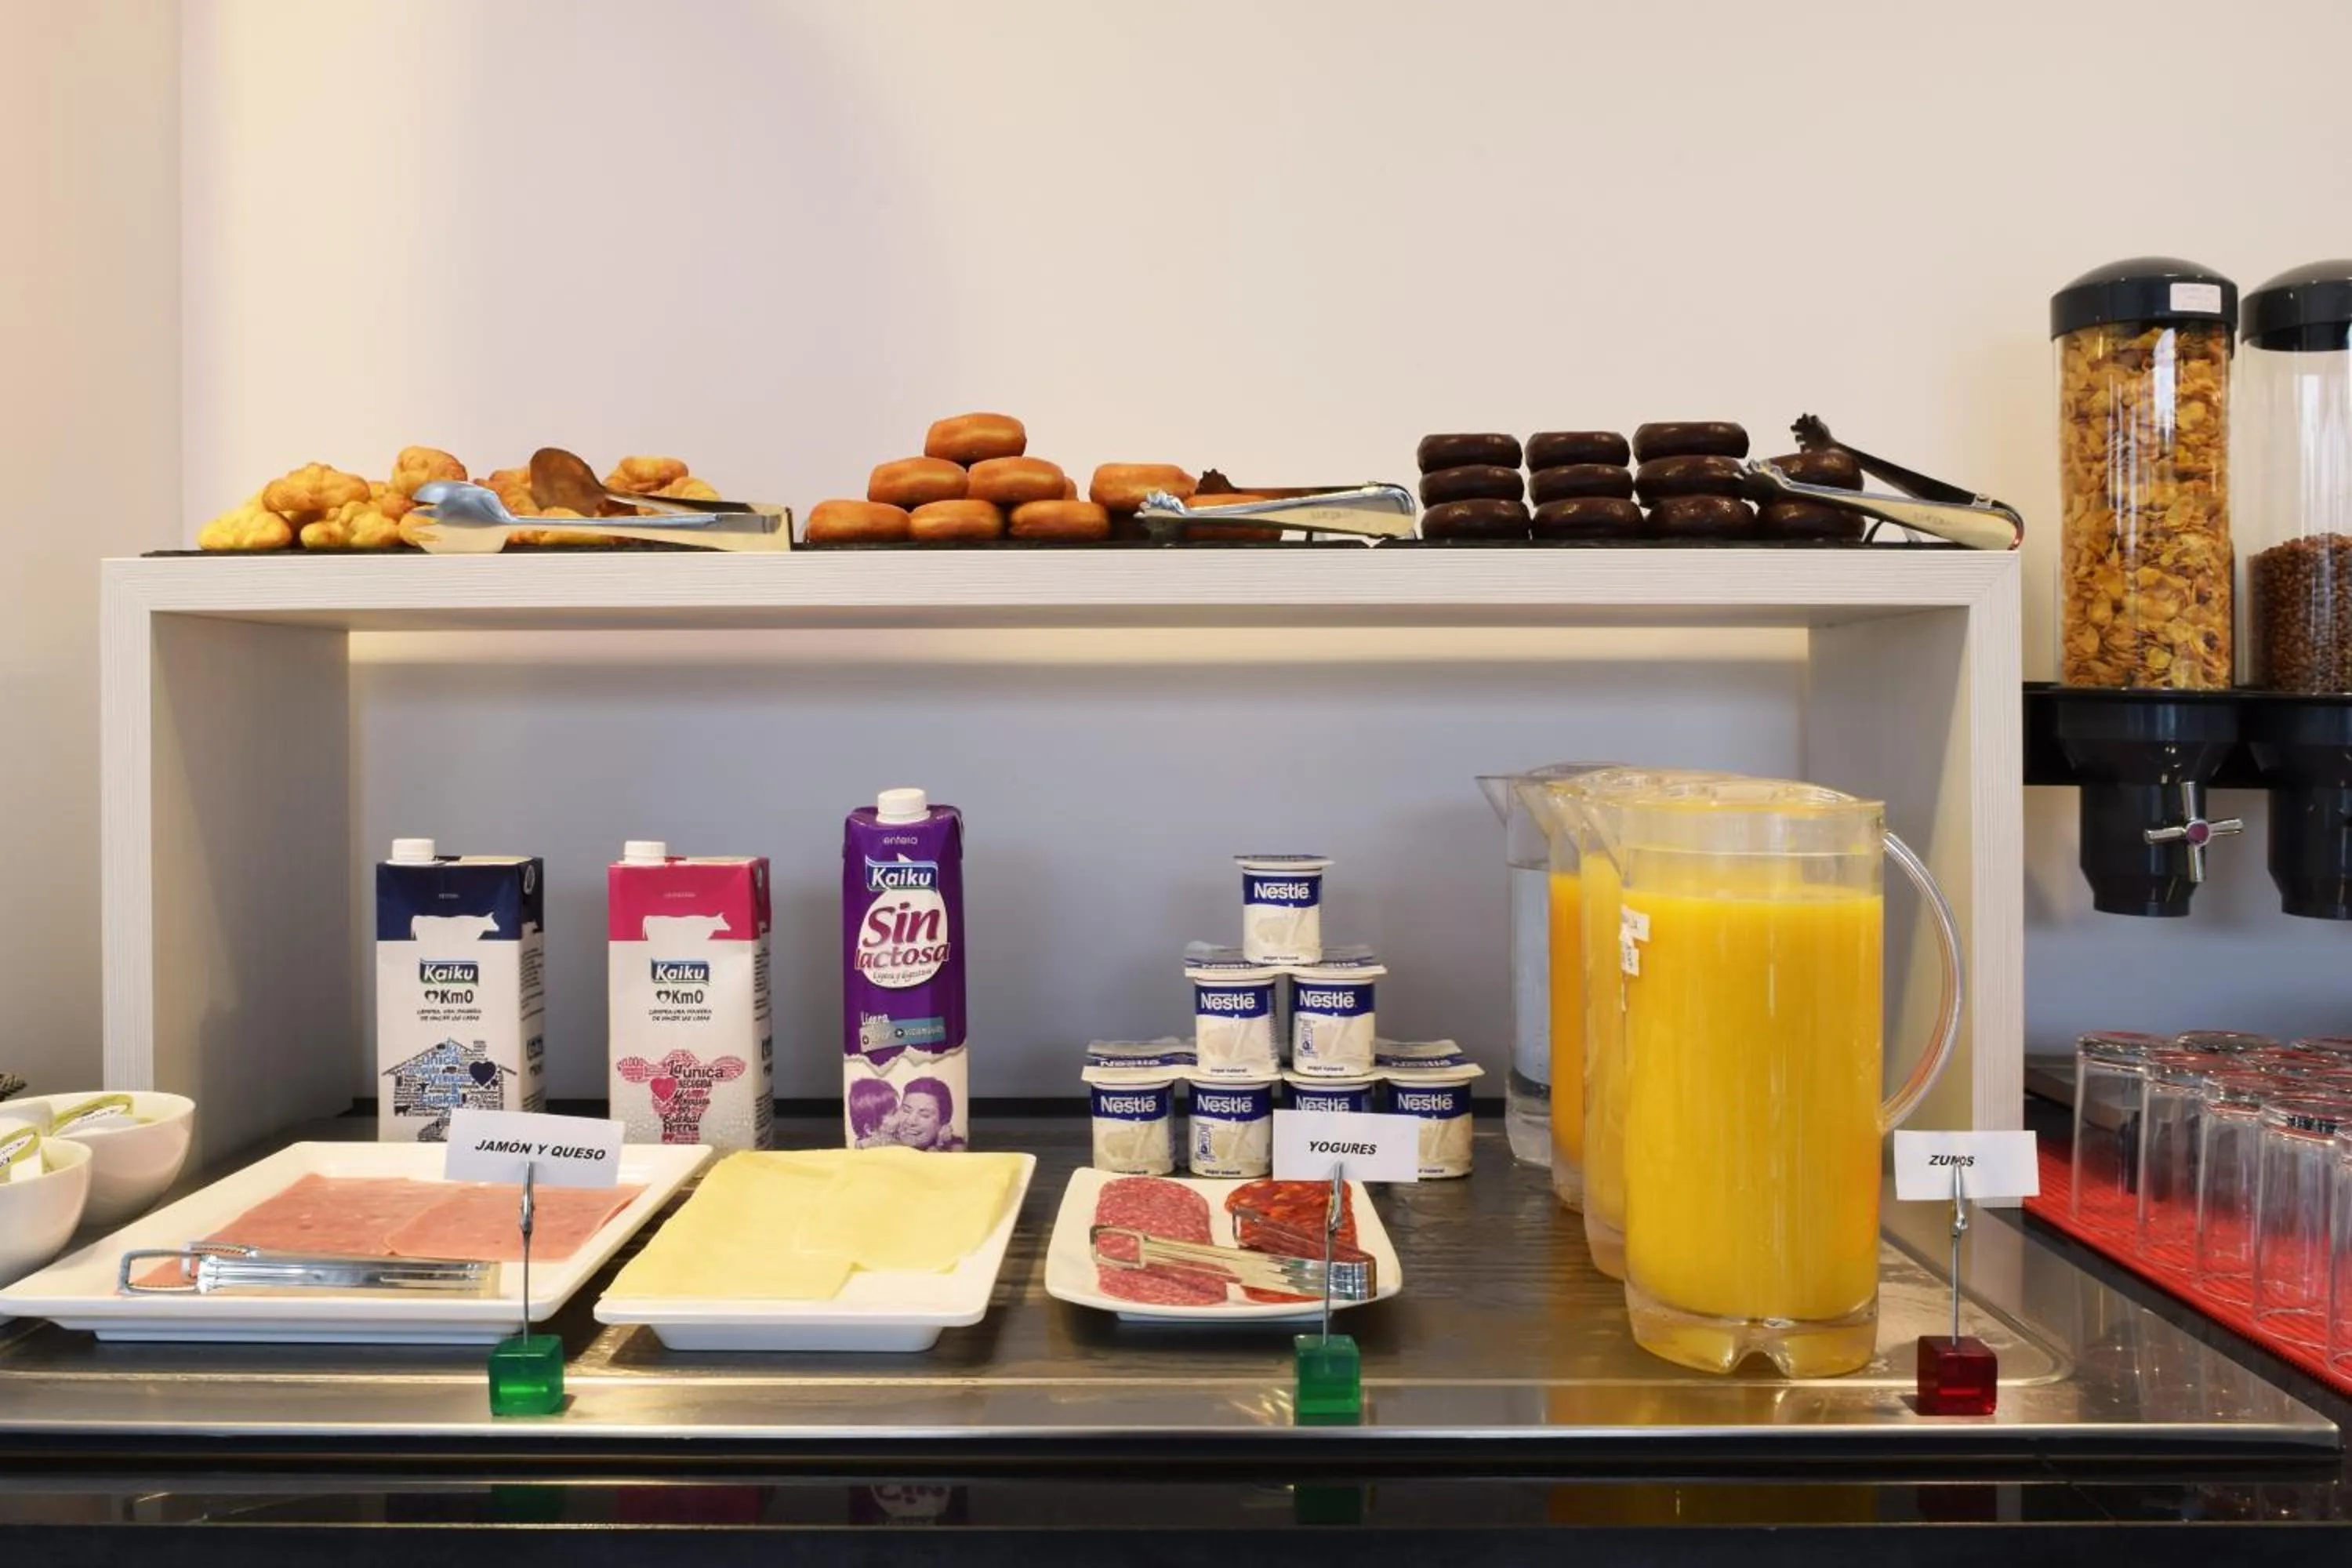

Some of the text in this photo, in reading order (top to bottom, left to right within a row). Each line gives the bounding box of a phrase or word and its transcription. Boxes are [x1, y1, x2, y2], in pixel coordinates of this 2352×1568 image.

[871, 866, 931, 888] Kaiku
[1254, 882, 1309, 899] Nestlé
[863, 902, 941, 949] Sin
[855, 942, 950, 970] lactosa
[423, 964, 474, 984] Kaiku
[655, 963, 706, 983] Kaiku
[1200, 992, 1255, 1010] Nestlé
[1299, 990, 1355, 1007] Nestlé
[1100, 1095, 1157, 1113] Nestlé
[1196, 1094, 1253, 1114] Nestlé
[1397, 1092, 1454, 1111] Nestlé
[474, 1139, 607, 1161] JAMÓN Y QUESO
[1308, 1141, 1377, 1156] YOGURES
